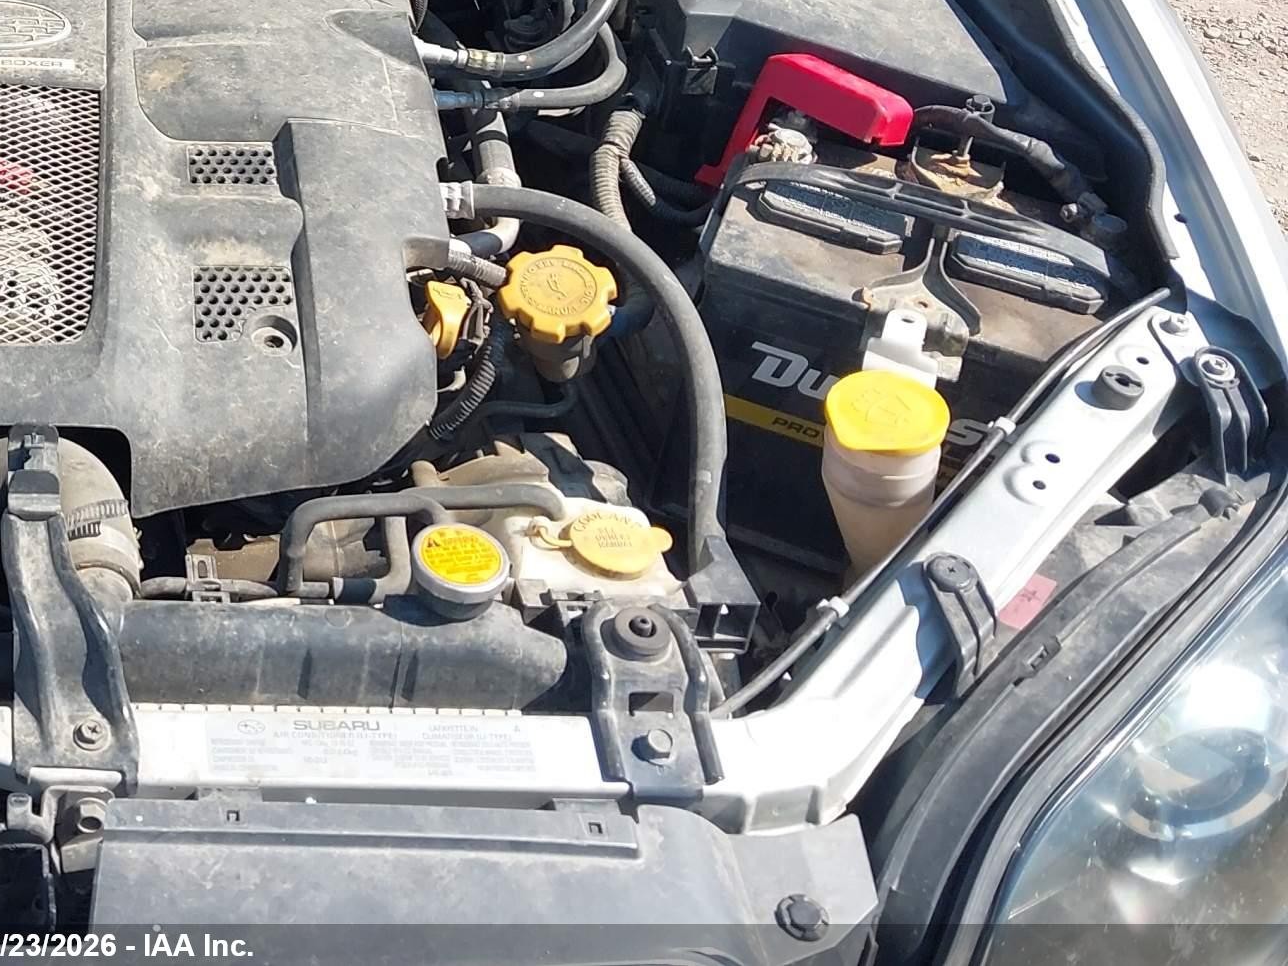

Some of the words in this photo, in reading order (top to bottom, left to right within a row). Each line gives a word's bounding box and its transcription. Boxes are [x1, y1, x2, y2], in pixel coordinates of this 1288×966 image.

[0, 60, 63, 68] BOXER
[751, 340, 842, 401] Du
[293, 720, 380, 731] SUBARU
